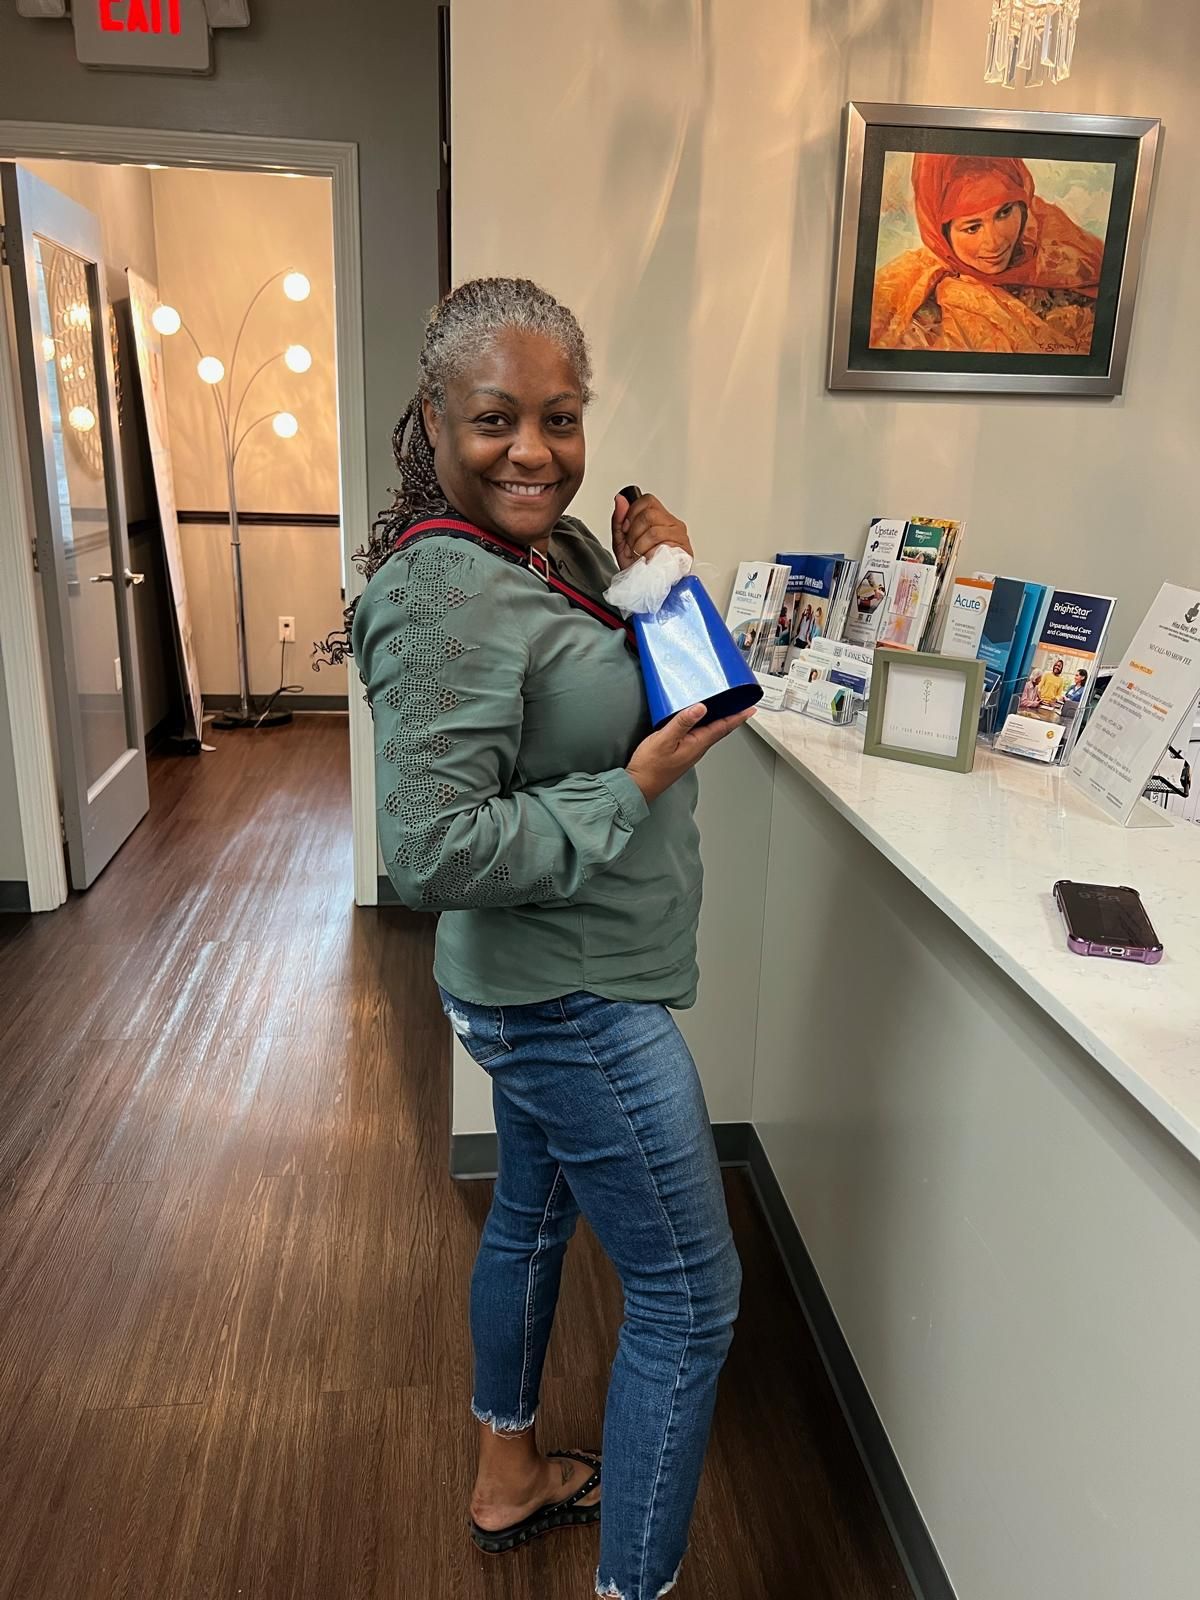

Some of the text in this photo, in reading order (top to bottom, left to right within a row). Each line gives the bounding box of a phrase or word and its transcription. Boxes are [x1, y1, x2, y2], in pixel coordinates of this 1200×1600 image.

[99, 0, 181, 36] EXIT
[874, 525, 898, 538] Upstate
[954, 594, 980, 610] Acute
[1053, 602, 1091, 616] BrightStar
[1055, 630, 1087, 642] Compassion
[1078, 627, 1092, 635] Care
